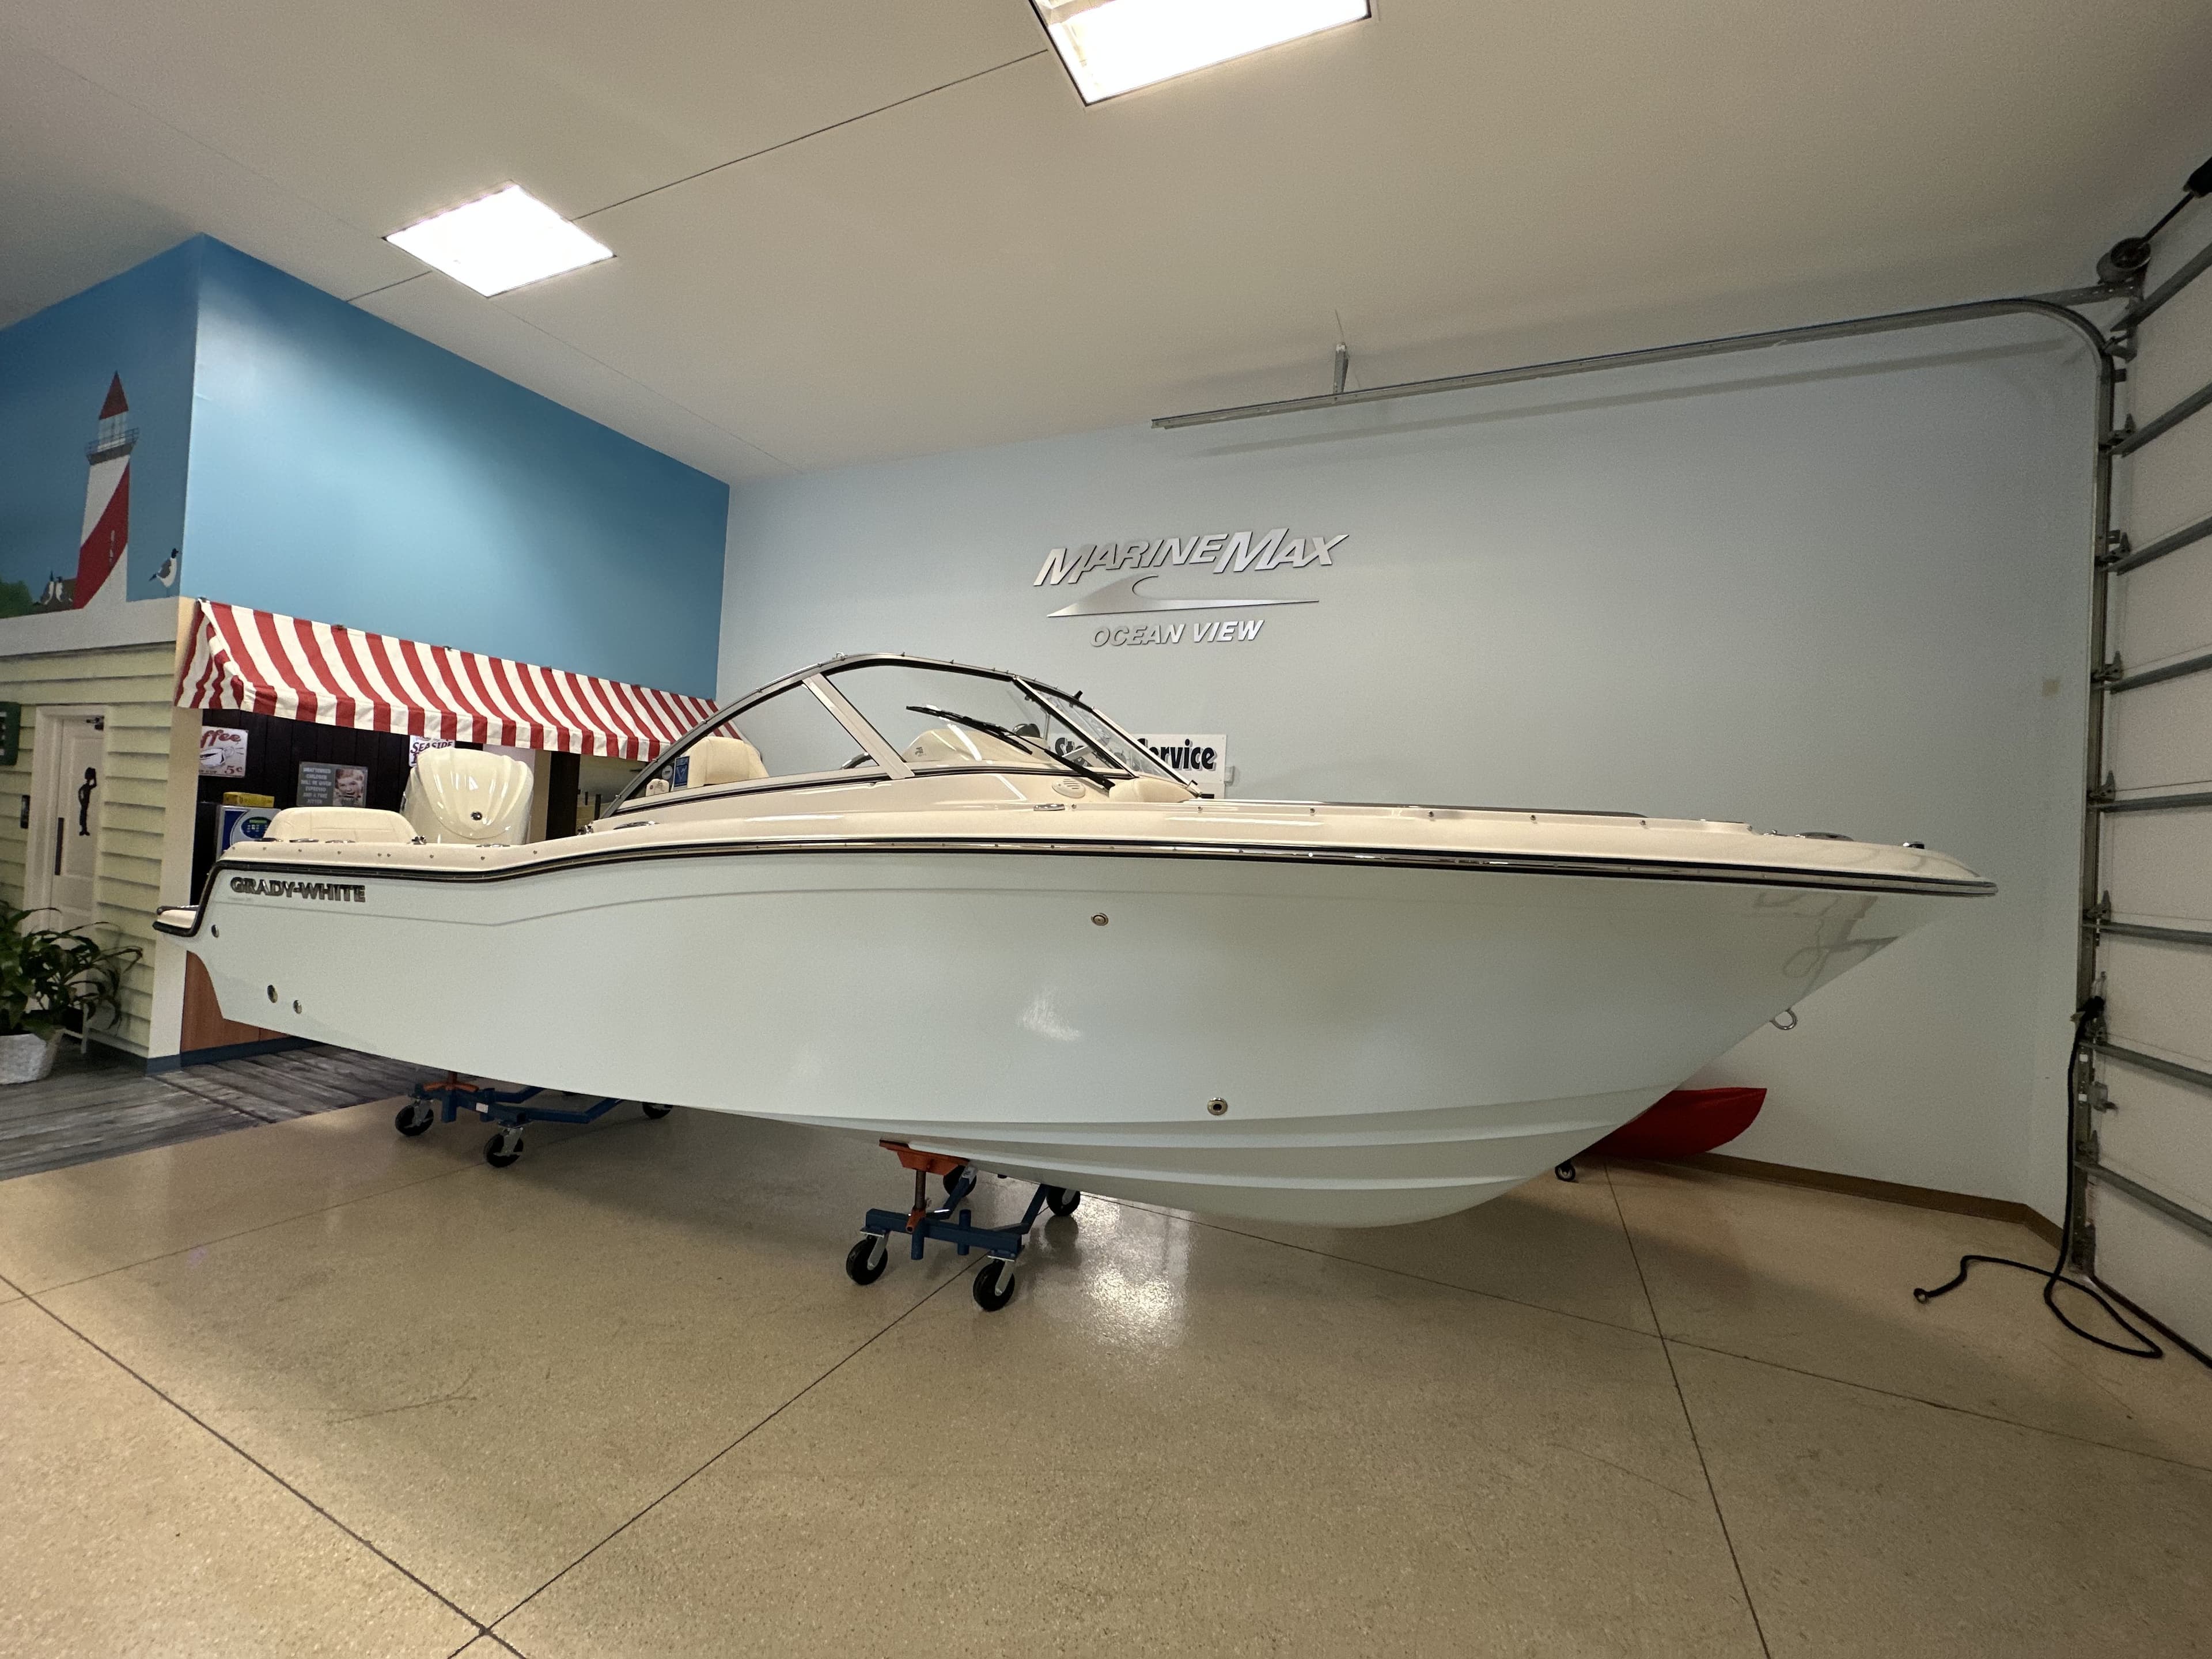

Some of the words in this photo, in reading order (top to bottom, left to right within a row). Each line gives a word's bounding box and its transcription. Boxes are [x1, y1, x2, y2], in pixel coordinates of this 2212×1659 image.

[1090, 623, 1185, 647] OCEAN
[1193, 620, 1264, 642] VIEW
[200, 729, 241, 748] ffee
[1137, 738, 1215, 771] ervice
[230, 877, 366, 903] GRADY-WHITE
